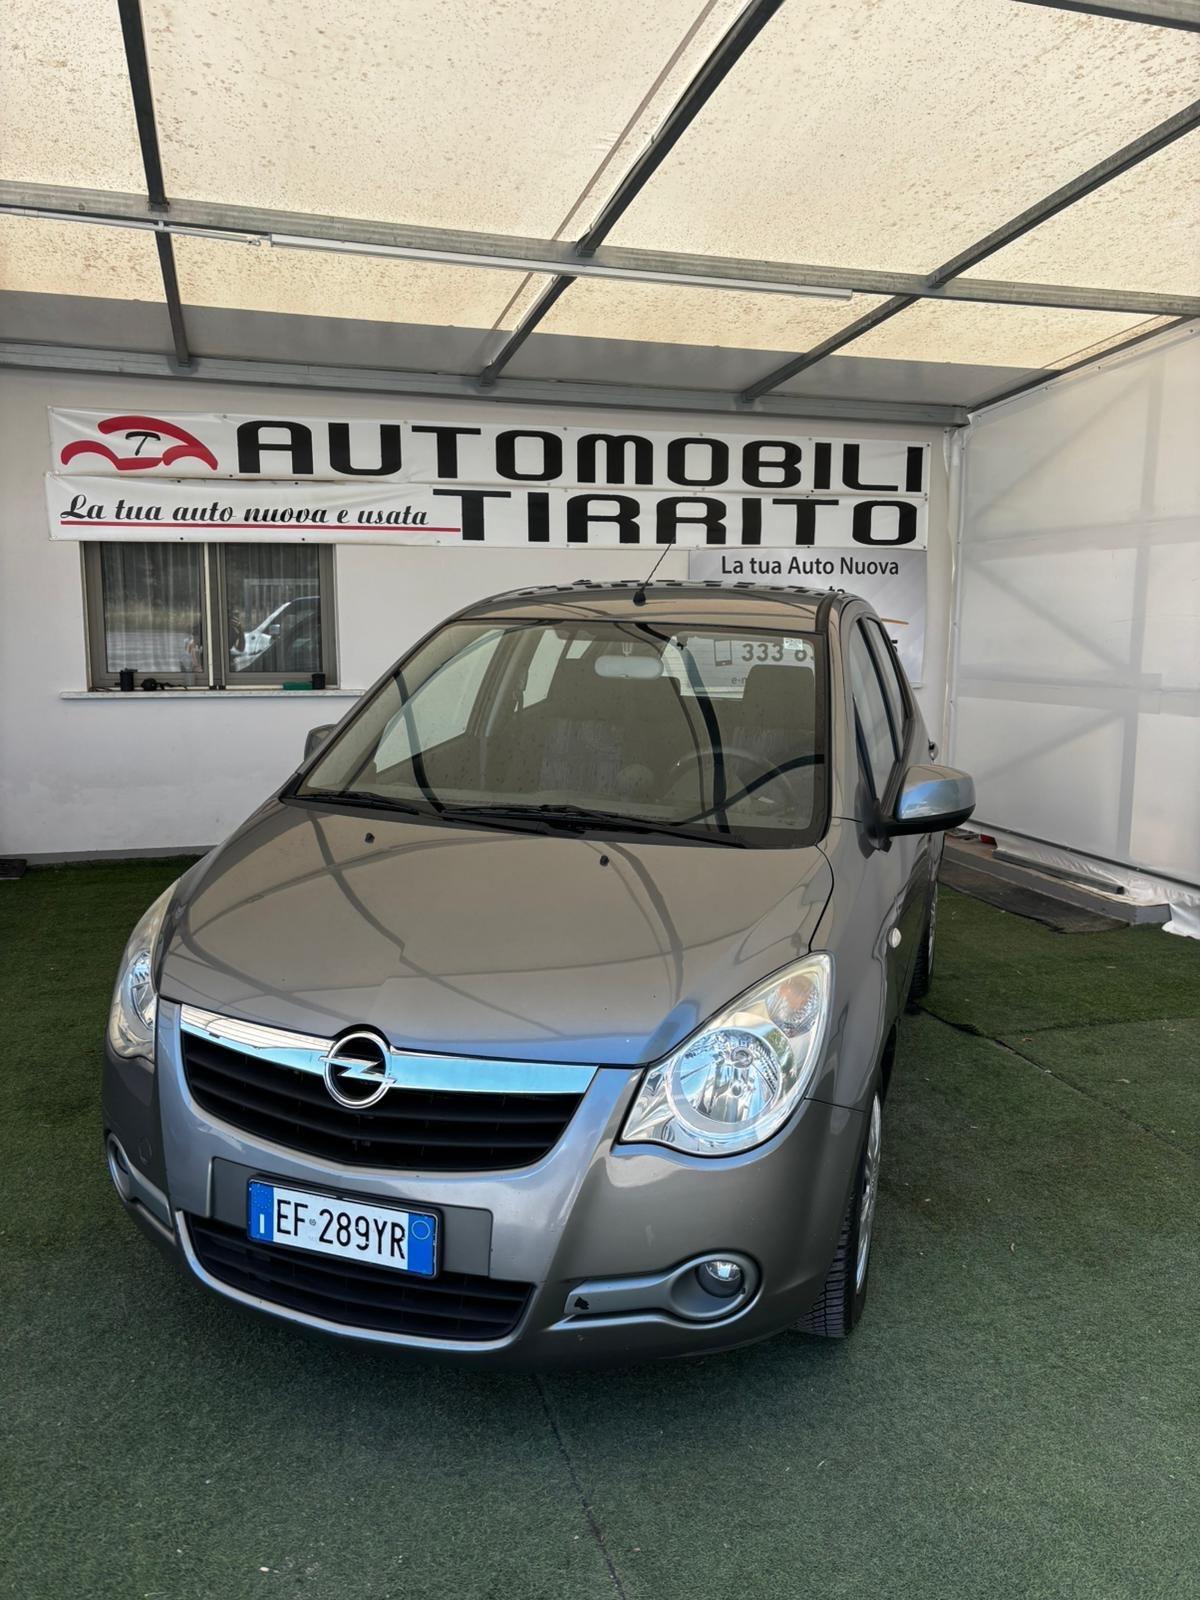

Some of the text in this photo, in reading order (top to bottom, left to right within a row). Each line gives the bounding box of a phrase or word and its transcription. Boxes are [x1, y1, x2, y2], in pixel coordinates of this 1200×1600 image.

[236, 420, 924, 493] AUTOMOBILI
[60, 494, 430, 527] La tua auto nuova e usata
[432, 488, 918, 546] TIRRITO
[721, 555, 899, 576] La tua Auto Nuova
[742, 642, 784, 662] 333
